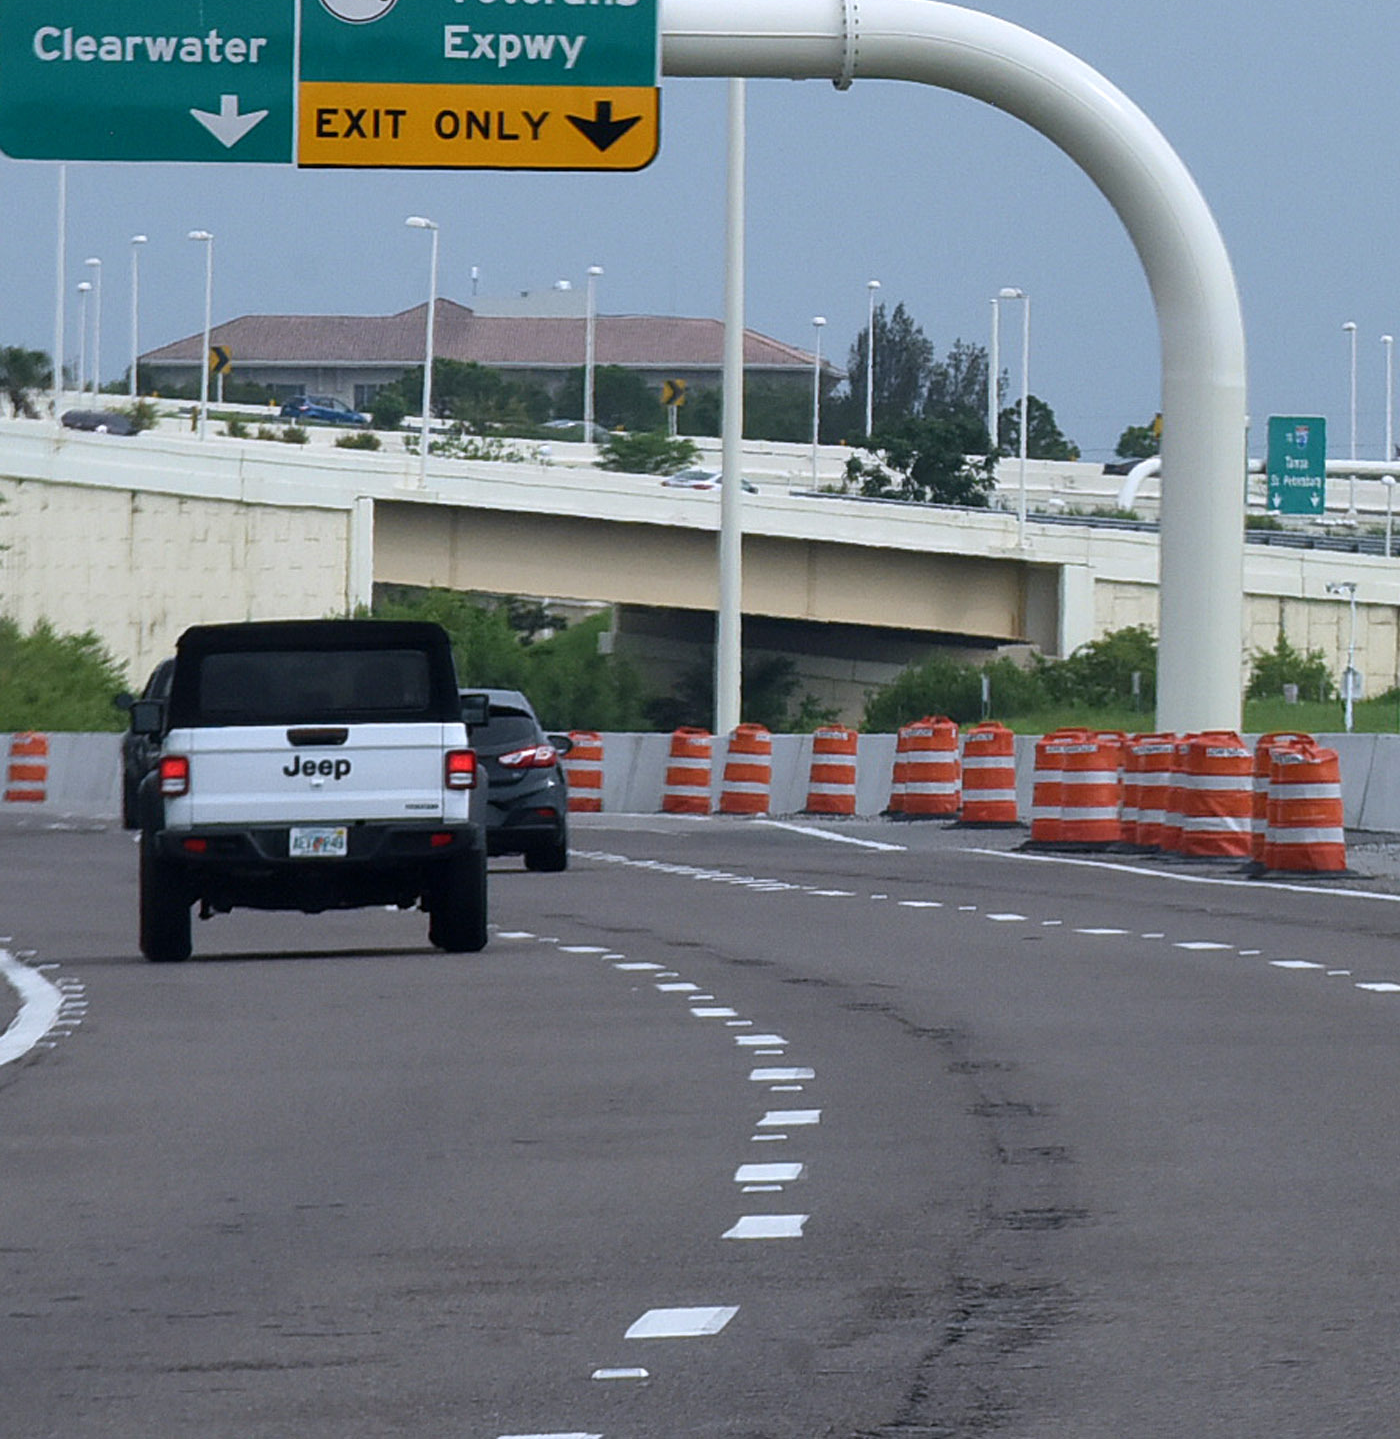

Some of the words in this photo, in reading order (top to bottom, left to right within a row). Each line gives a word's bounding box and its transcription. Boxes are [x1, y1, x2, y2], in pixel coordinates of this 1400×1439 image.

[33, 25, 267, 65] Clearwater
[443, 24, 587, 69] Expwy
[315, 108, 409, 140] EXIT
[434, 109, 551, 142] ONLY
[282, 755, 352, 781] Jeep
